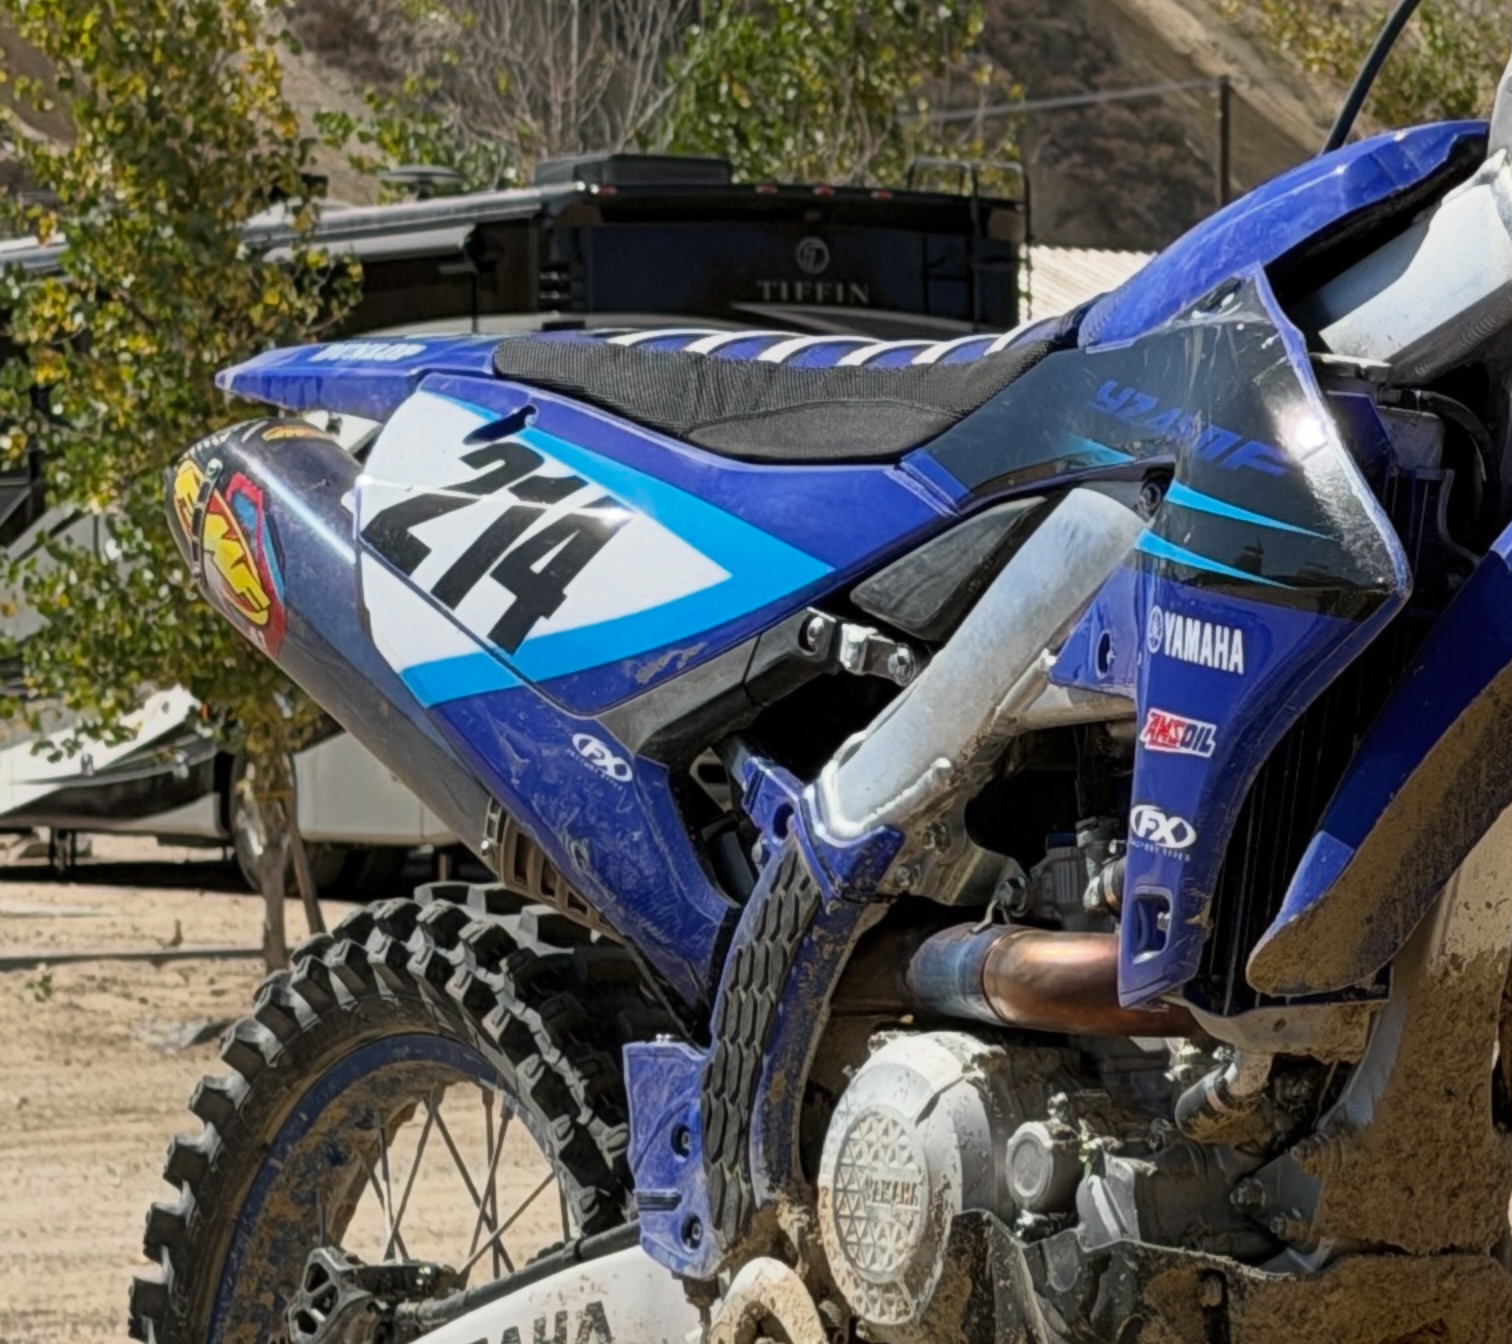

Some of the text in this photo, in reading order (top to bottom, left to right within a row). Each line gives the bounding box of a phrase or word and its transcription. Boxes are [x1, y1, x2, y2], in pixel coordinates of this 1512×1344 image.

[756, 280, 870, 304] TIFFIN
[360, 441, 634, 657] 214
[1164, 610, 1245, 675] YAMAHA
[1145, 711, 1214, 754] AMSOIL
